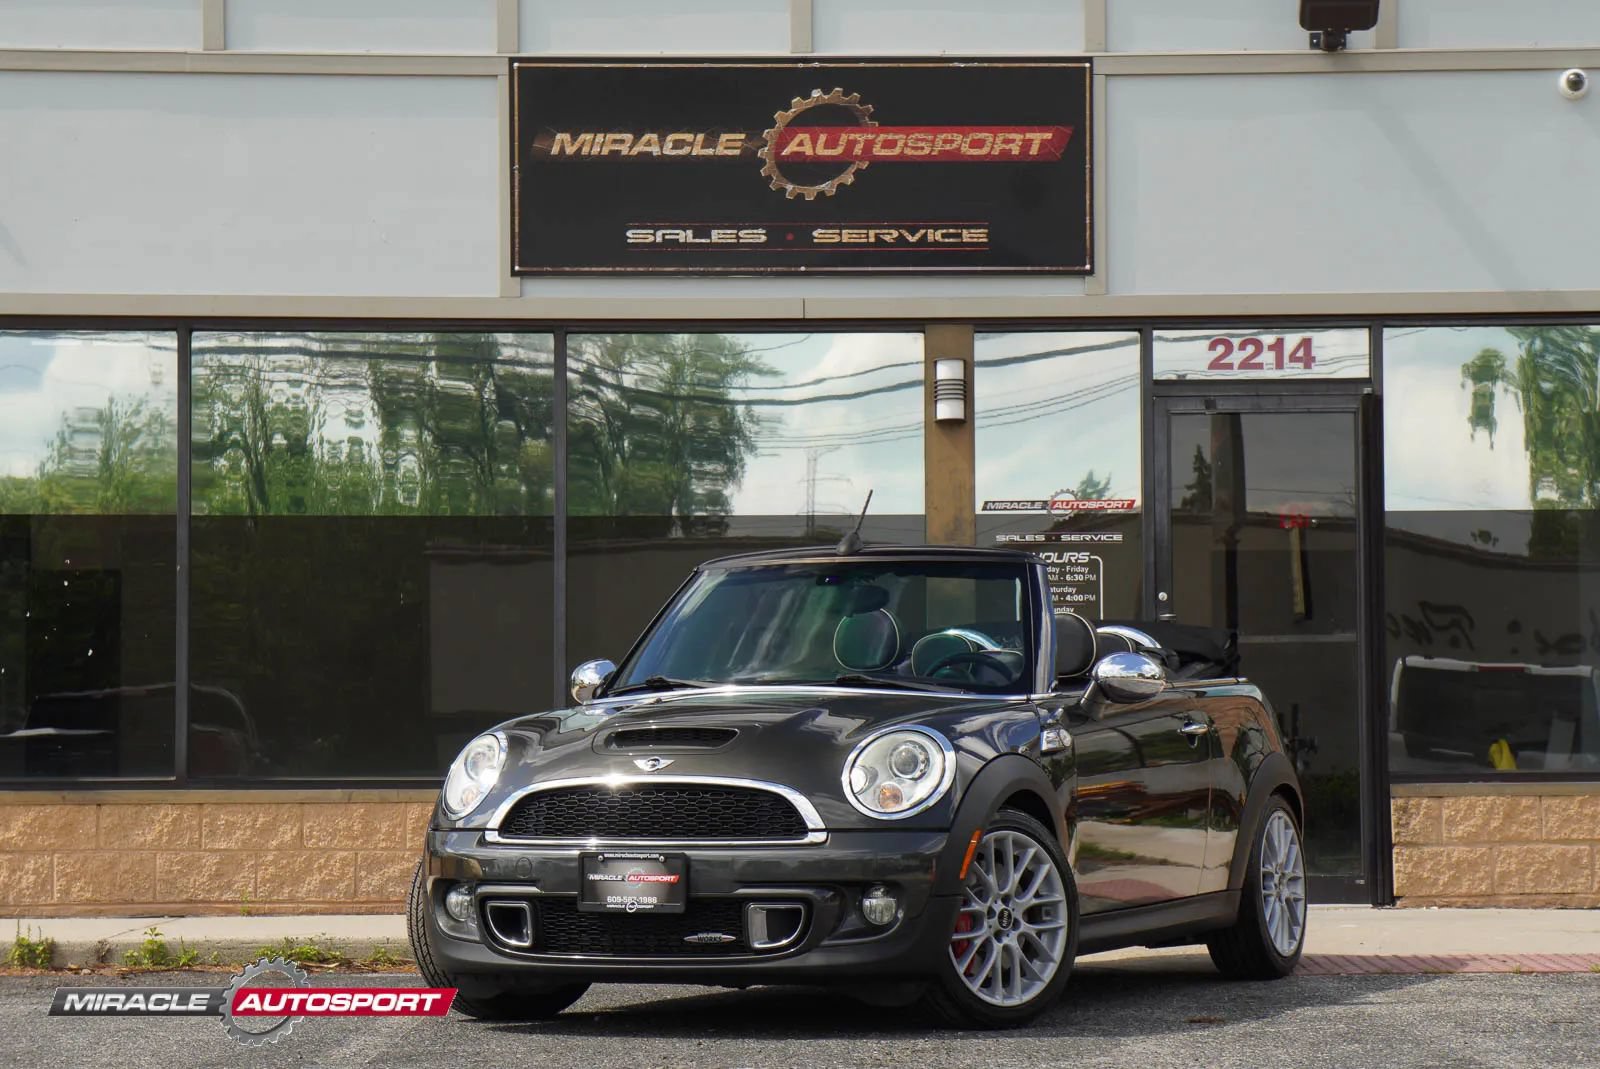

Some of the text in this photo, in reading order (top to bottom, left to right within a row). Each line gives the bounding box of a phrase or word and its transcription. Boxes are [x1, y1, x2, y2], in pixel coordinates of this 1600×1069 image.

[550, 132, 1053, 157] MIRACLE AUTOSPORT
[626, 228, 988, 244] SALES SERVICE
[1207, 336, 1316, 370] 2214
[1053, 500, 1131, 509] AUTOSPORT
[1066, 566, 1089, 574] Friday
[1049, 586, 1076, 594] aturday
